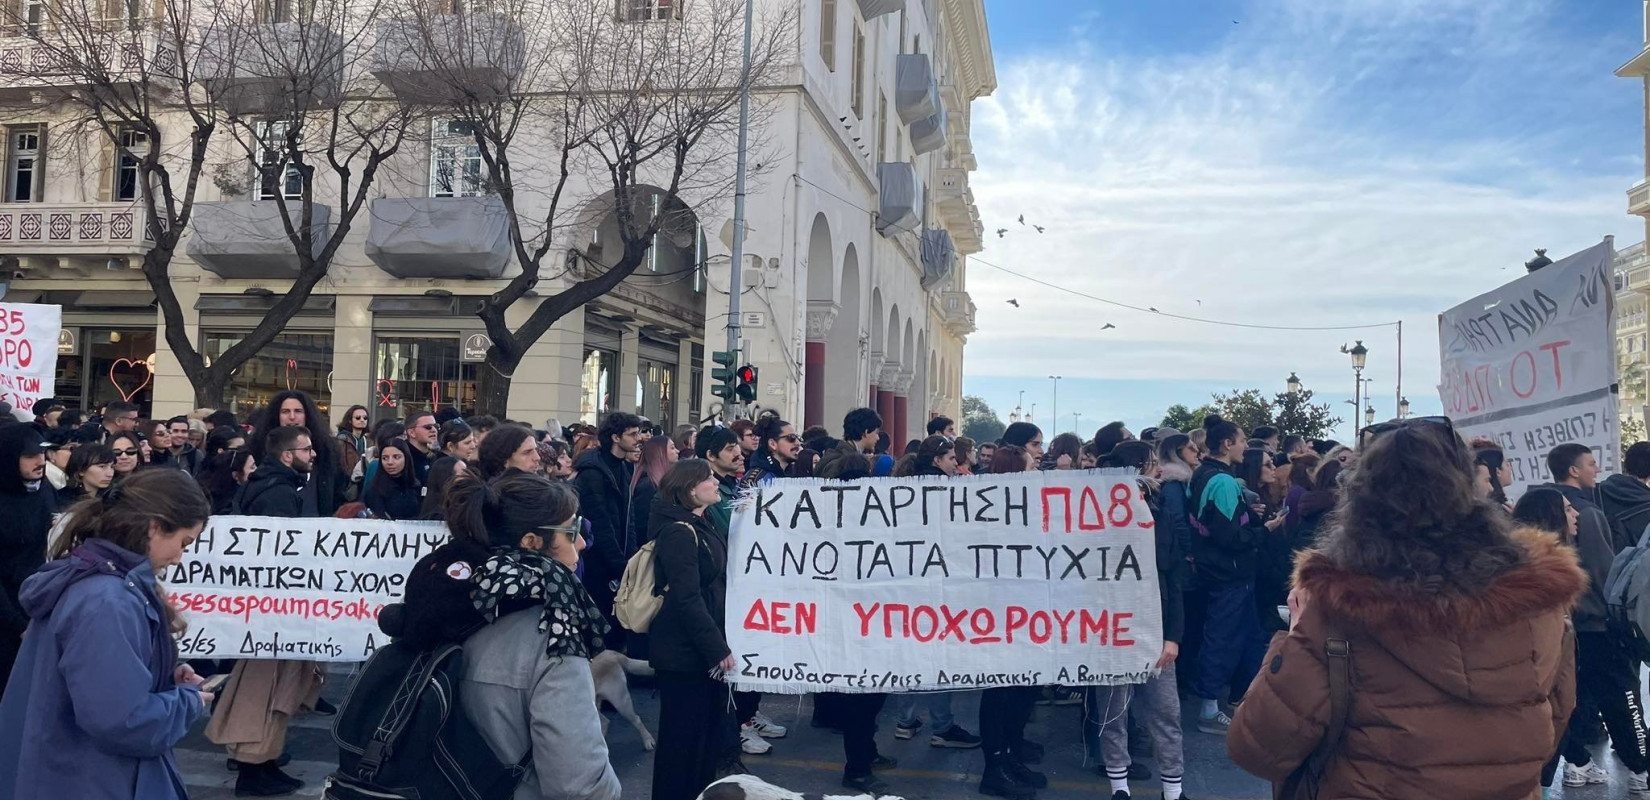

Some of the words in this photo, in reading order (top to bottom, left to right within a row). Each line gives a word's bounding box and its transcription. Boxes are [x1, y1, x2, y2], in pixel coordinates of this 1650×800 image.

[0, 338, 32, 368] ΡΟ
[754, 485, 1028, 529] ΚΑΤΑΡΓΗΣΗ
[183, 527, 214, 555] Η
[224, 527, 302, 557] ΣΤΙΣ
[314, 529, 453, 560] ΚΑΤΑΛΗΨ
[171, 560, 323, 590] ΔΡΑΜΑΤΙΚΩΝ
[744, 540, 950, 580] ΑΝΩΤΑΤΑ
[967, 543, 1143, 582] ΠΤΥΧΙΑ
[743, 598, 817, 636] ΔΕΝ
[853, 601, 1135, 646] ΥΠΟΧΩΡΟΥΜΕ
[240, 630, 343, 657] Δραματικής
[937, 669, 1042, 686] Δραματικής
